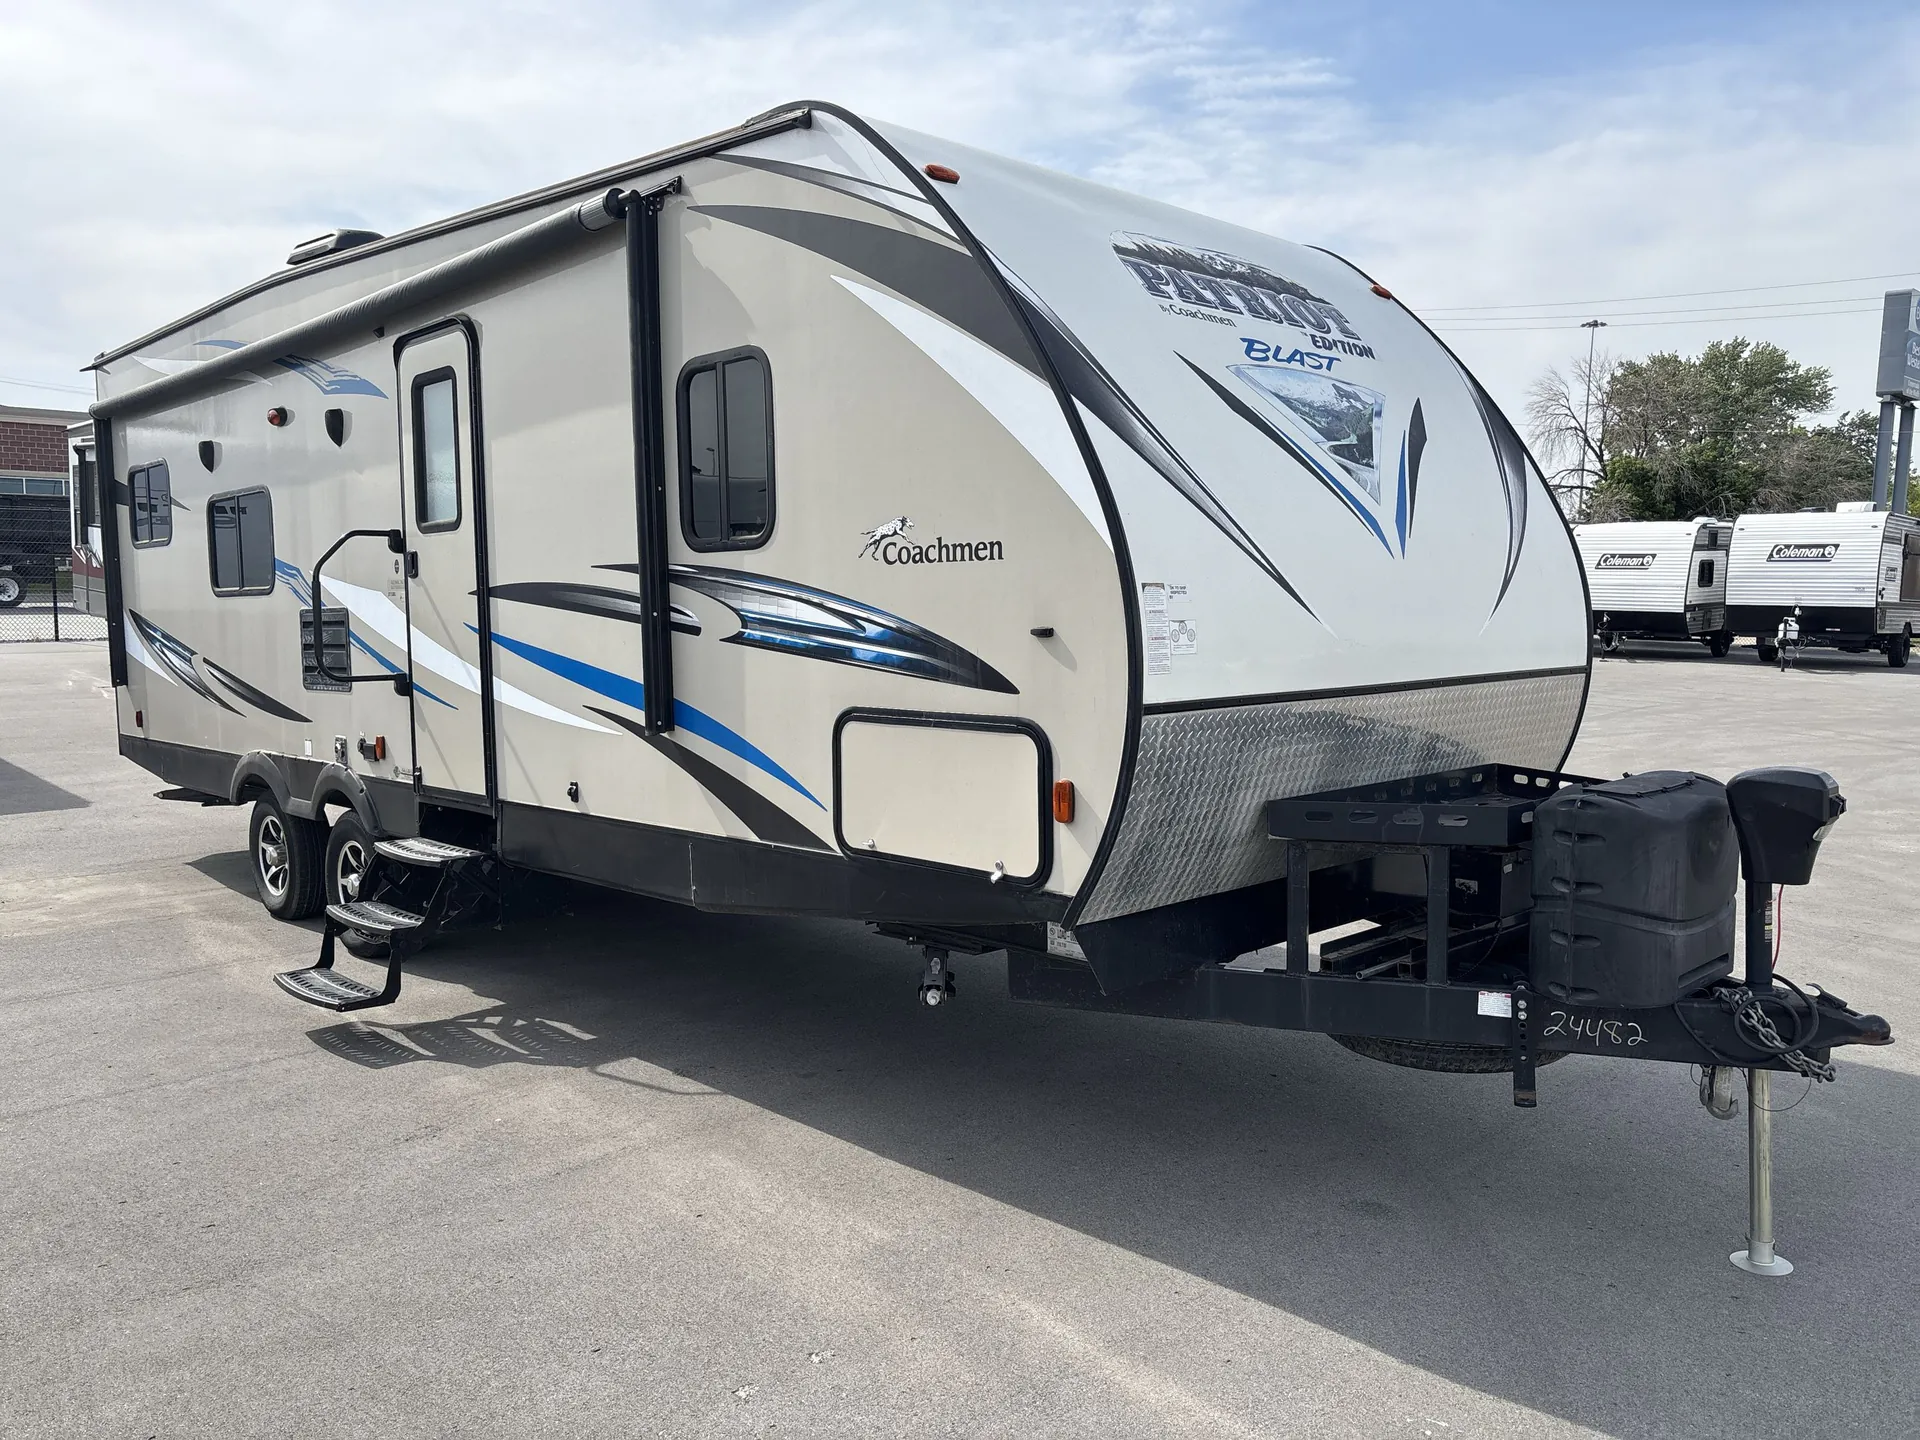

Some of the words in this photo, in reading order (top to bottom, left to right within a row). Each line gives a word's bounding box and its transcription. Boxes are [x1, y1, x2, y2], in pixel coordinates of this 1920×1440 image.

[1122, 256, 1362, 341] PATRIOT
[1169, 304, 1237, 328] Coachmen
[1239, 337, 1342, 372] BLAST
[1309, 333, 1376, 360] EDITION
[882, 536, 1004, 566] Coachmen
[1600, 554, 1643, 567] Coleman
[1773, 544, 1824, 559] Coleman
[1543, 1011, 1649, 1047] 24482
